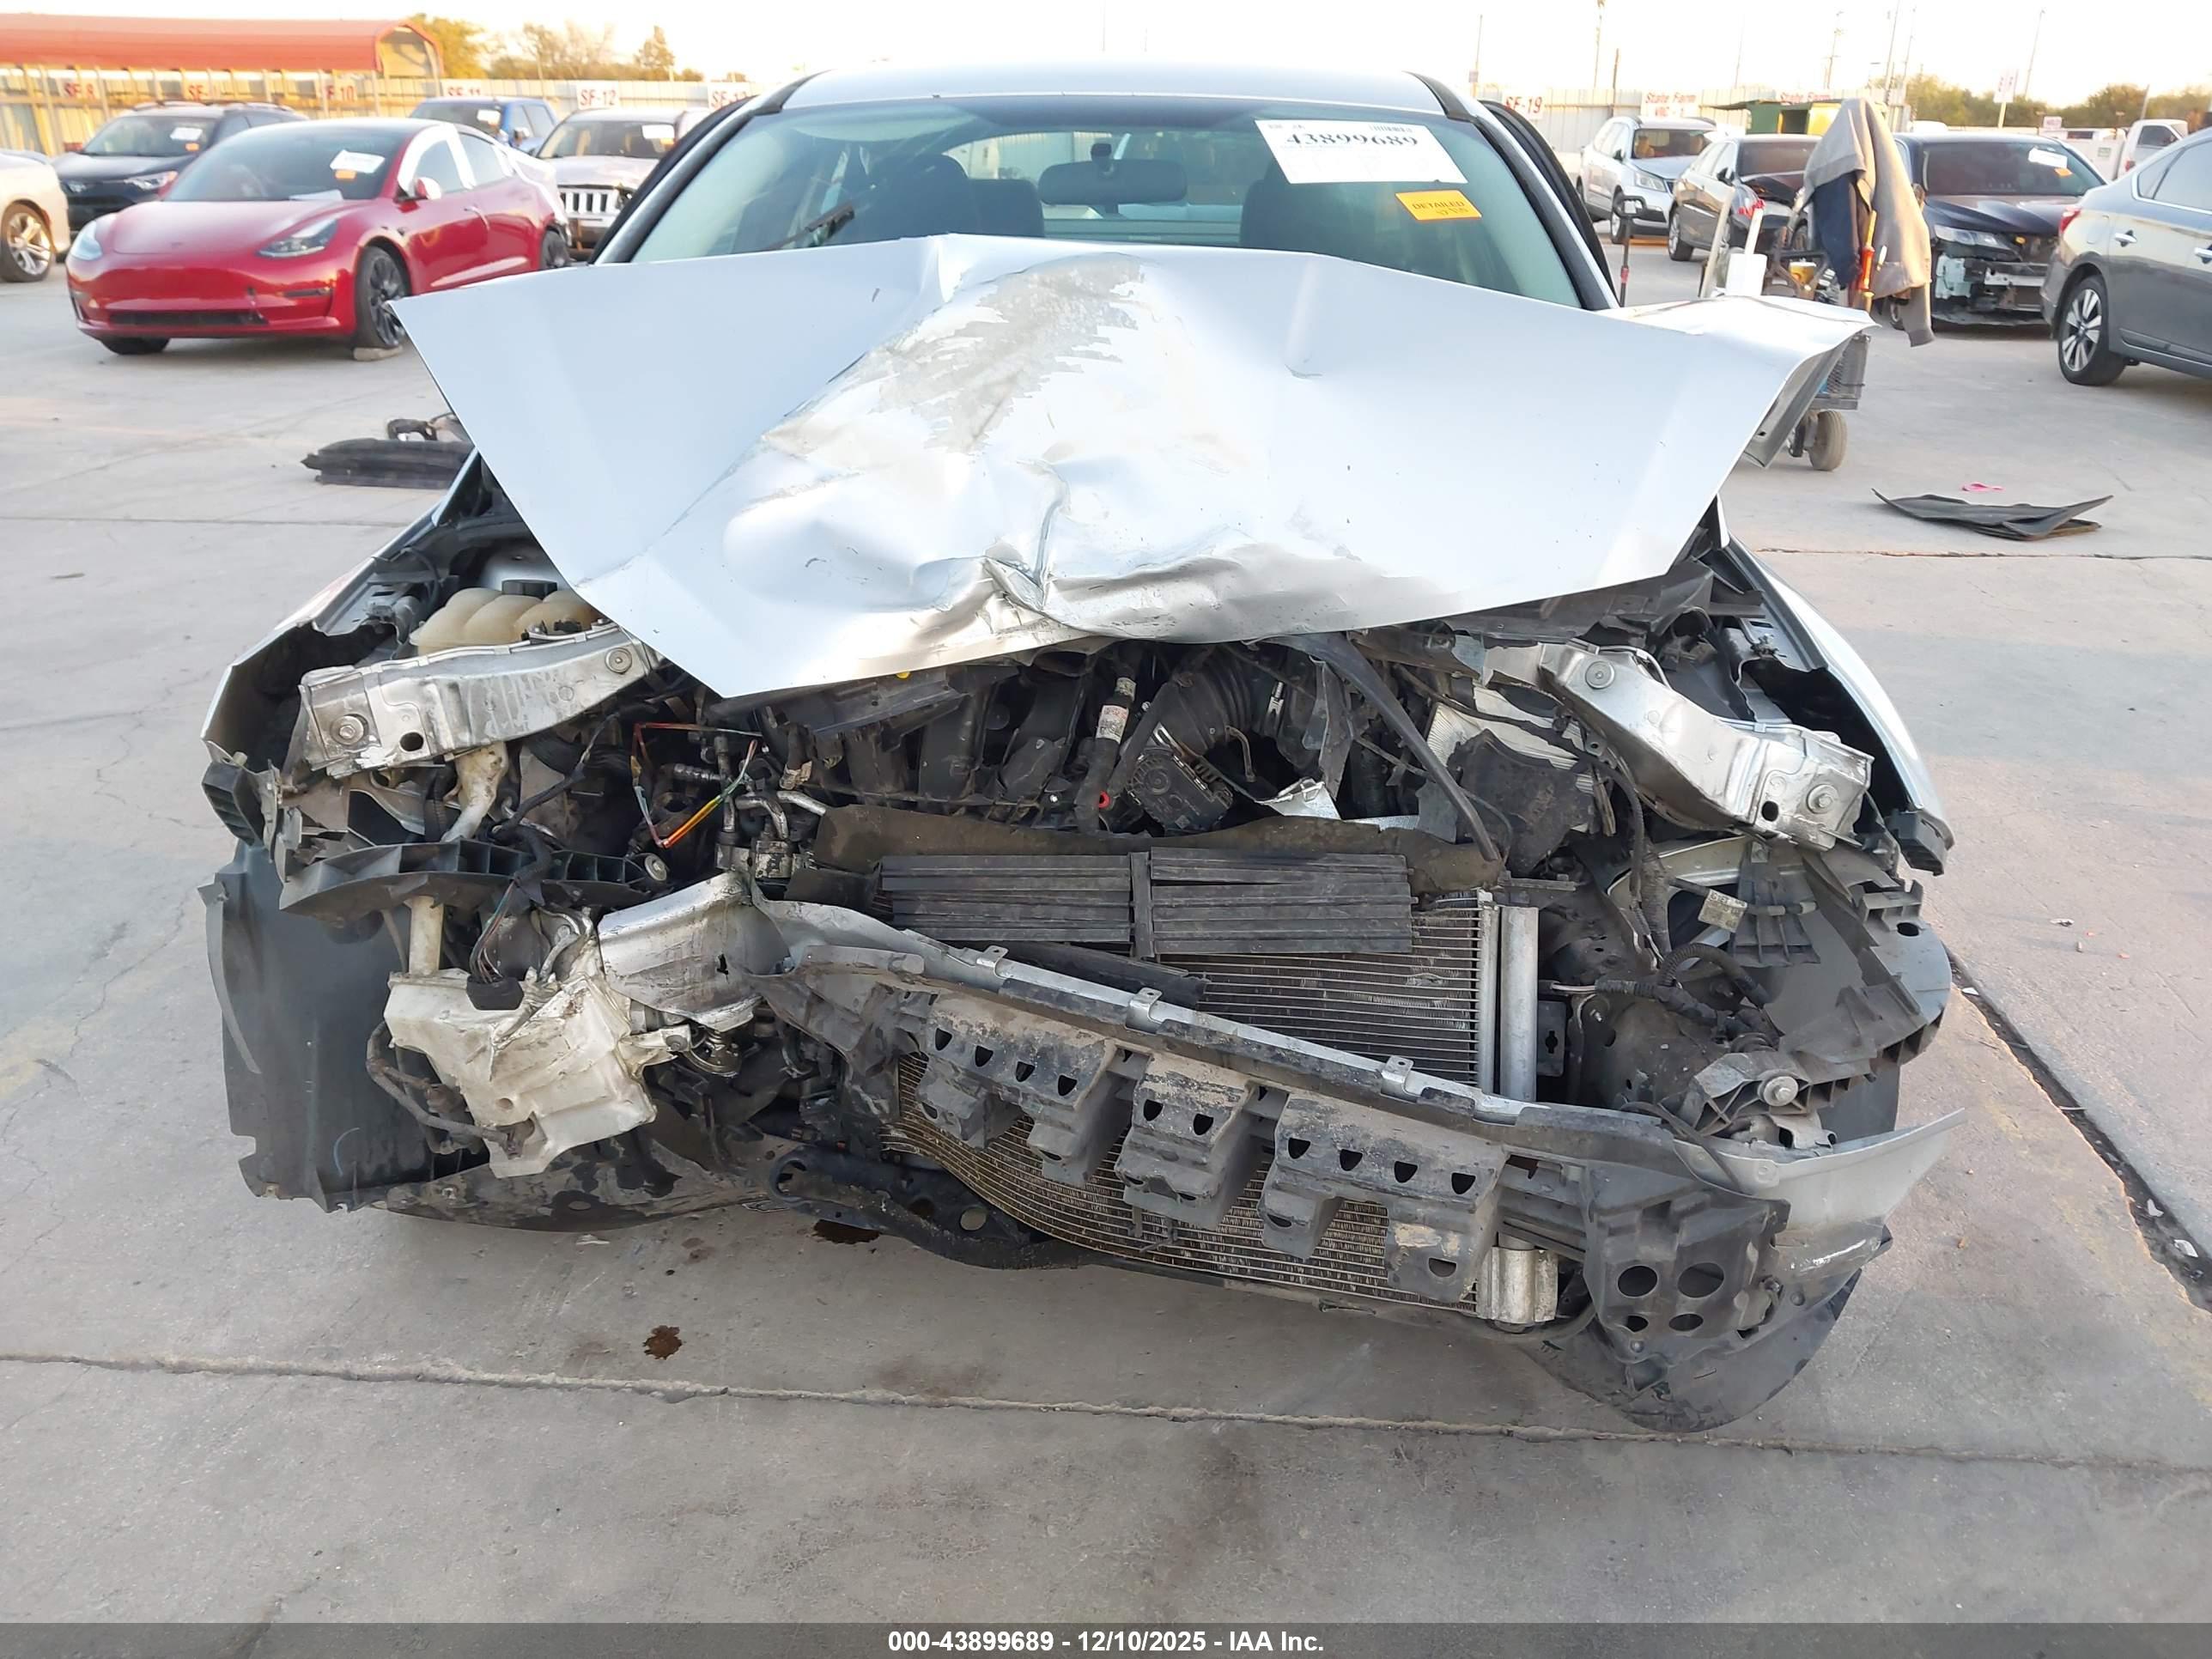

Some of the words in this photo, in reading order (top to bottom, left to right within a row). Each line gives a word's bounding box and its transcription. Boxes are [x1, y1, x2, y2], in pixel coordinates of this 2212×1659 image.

[579, 89, 617, 106] SF-12
[1505, 95, 1543, 114] SF-19
[1285, 133, 1419, 146] 43899689
